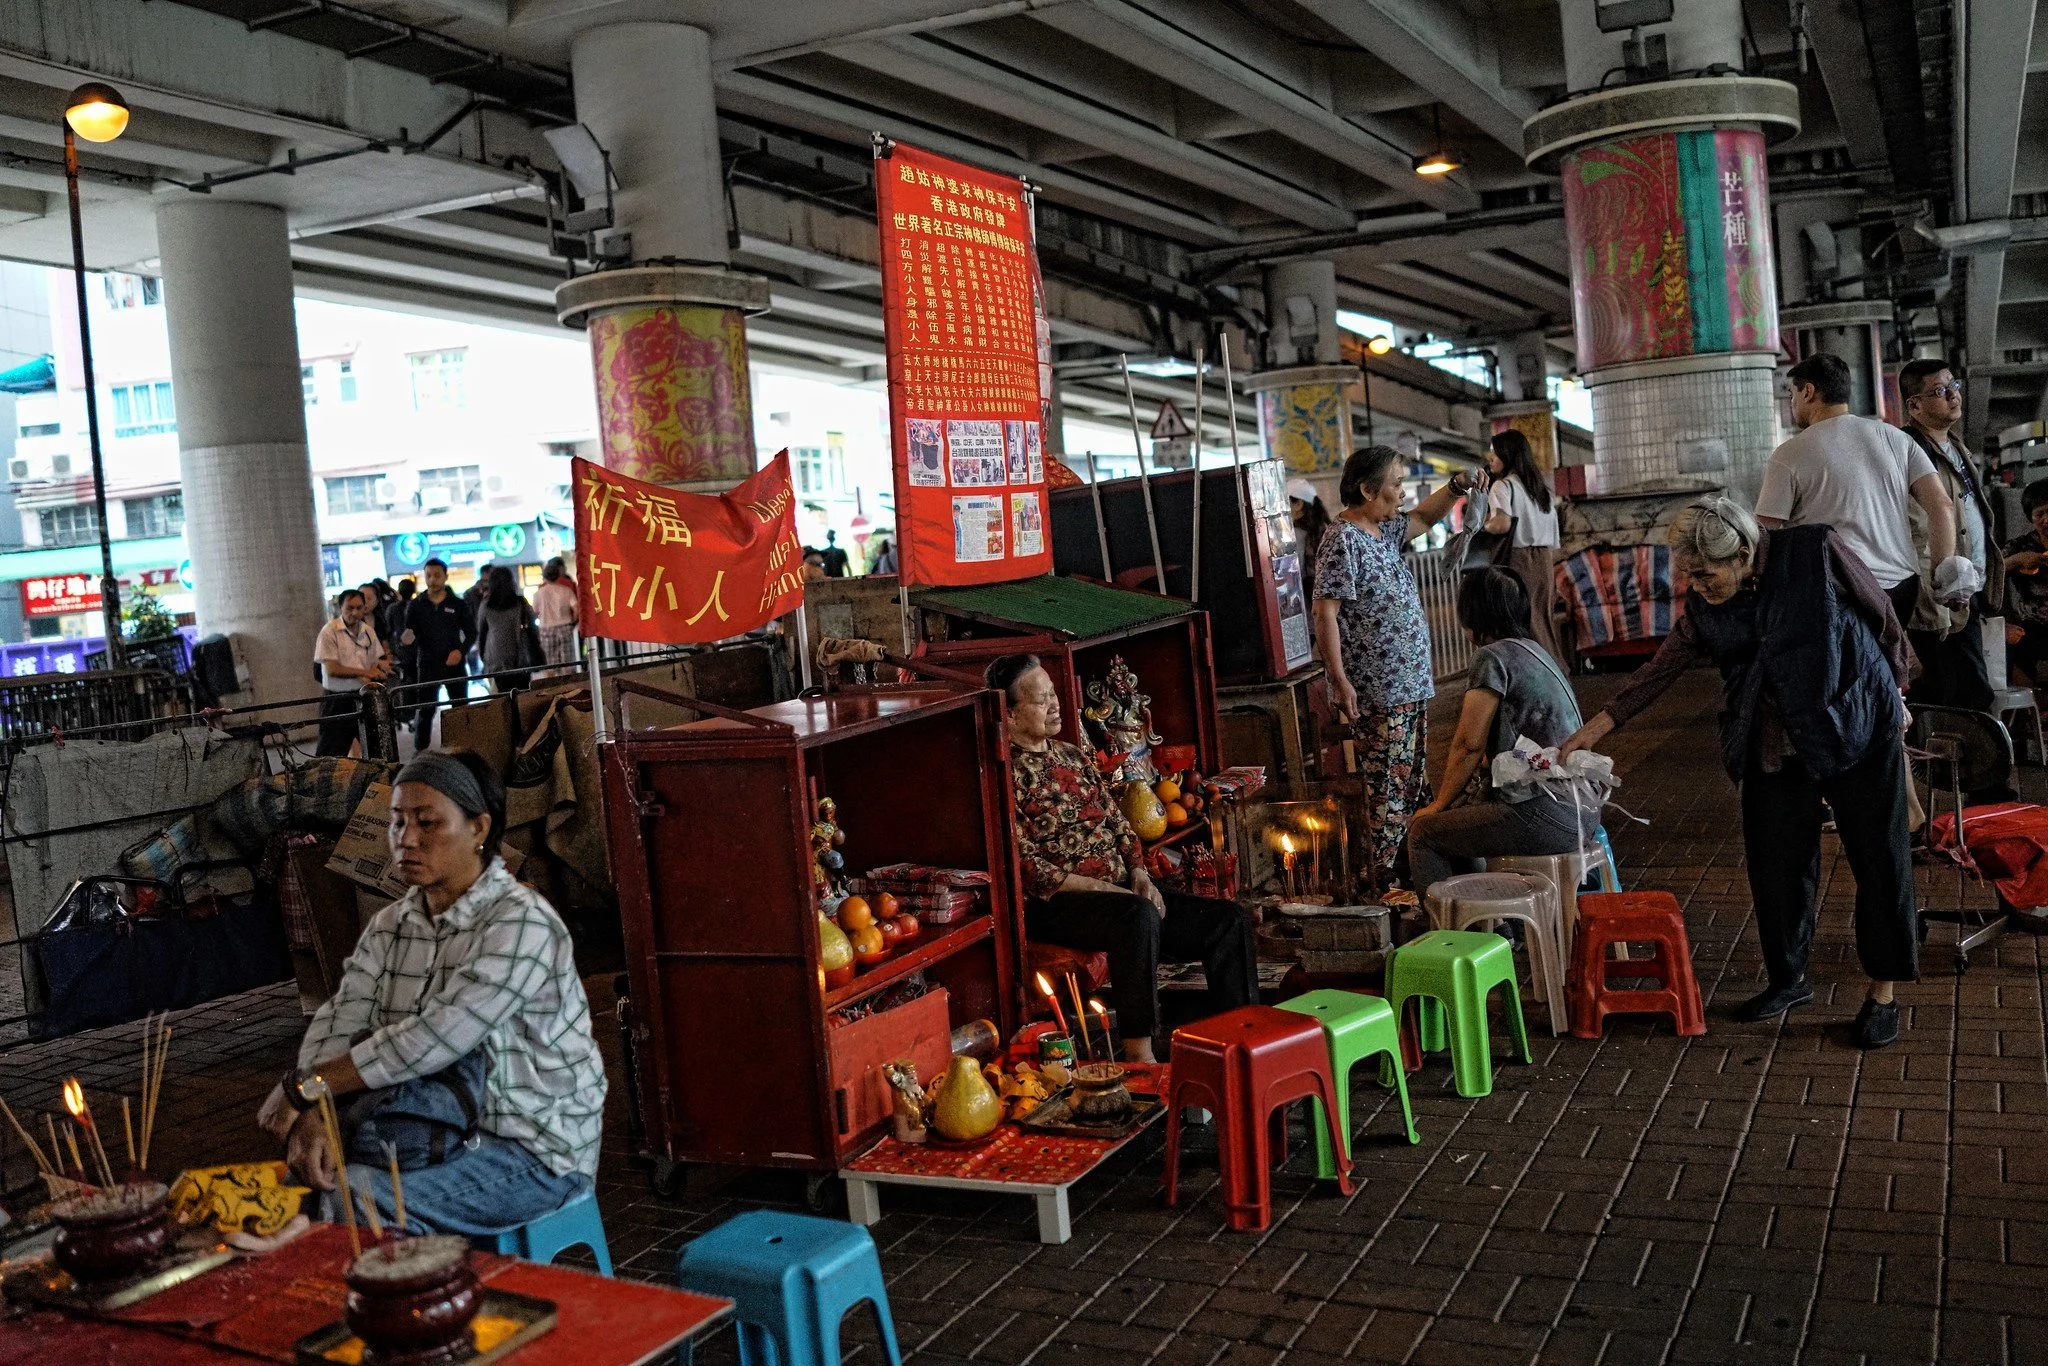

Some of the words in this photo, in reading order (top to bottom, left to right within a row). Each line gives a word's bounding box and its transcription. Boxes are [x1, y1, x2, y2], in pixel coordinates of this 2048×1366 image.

[900, 164, 1017, 213] 趙姑神婆求神保平安
[930, 195, 1006, 229] 香港政府發牌
[1720, 172, 1748, 250] 芒種
[582, 468, 692, 548] 祈福
[589, 553, 730, 626] 打小人
